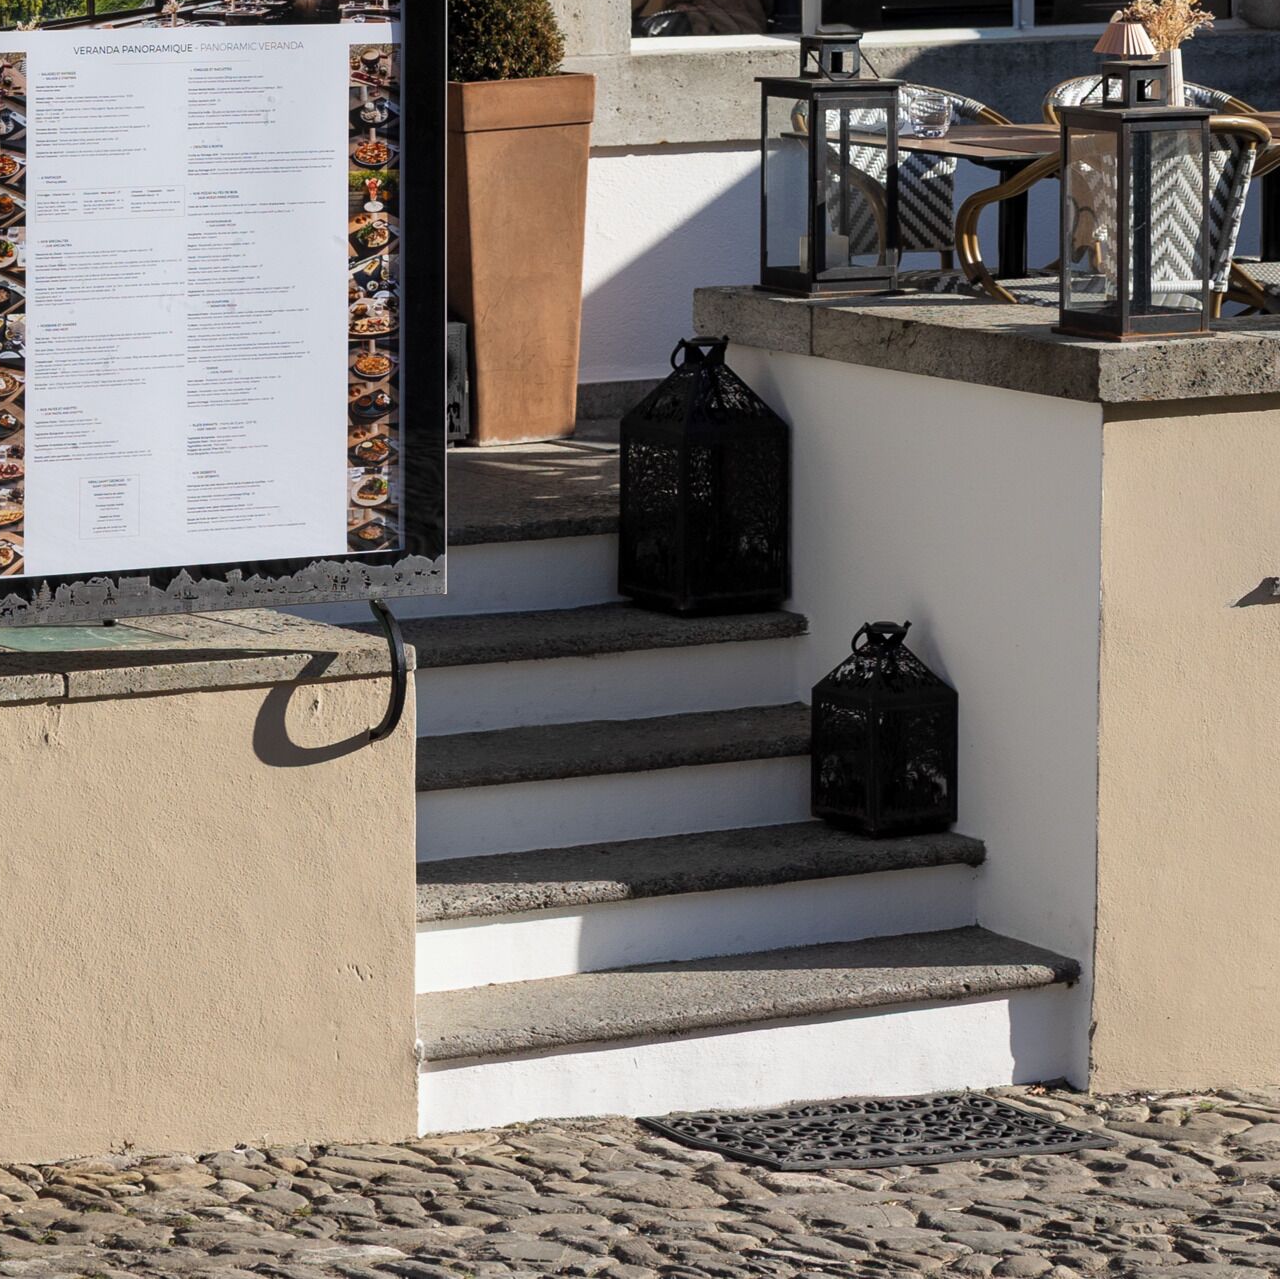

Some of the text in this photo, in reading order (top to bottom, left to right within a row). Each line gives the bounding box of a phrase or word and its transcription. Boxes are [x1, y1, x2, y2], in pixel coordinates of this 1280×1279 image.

[73, 46, 120, 55] VERANDA
[122, 43, 193, 54] PANORAMIQUE
[200, 42, 256, 52] PANORAMIC
[258, 40, 305, 51] VERANDA
